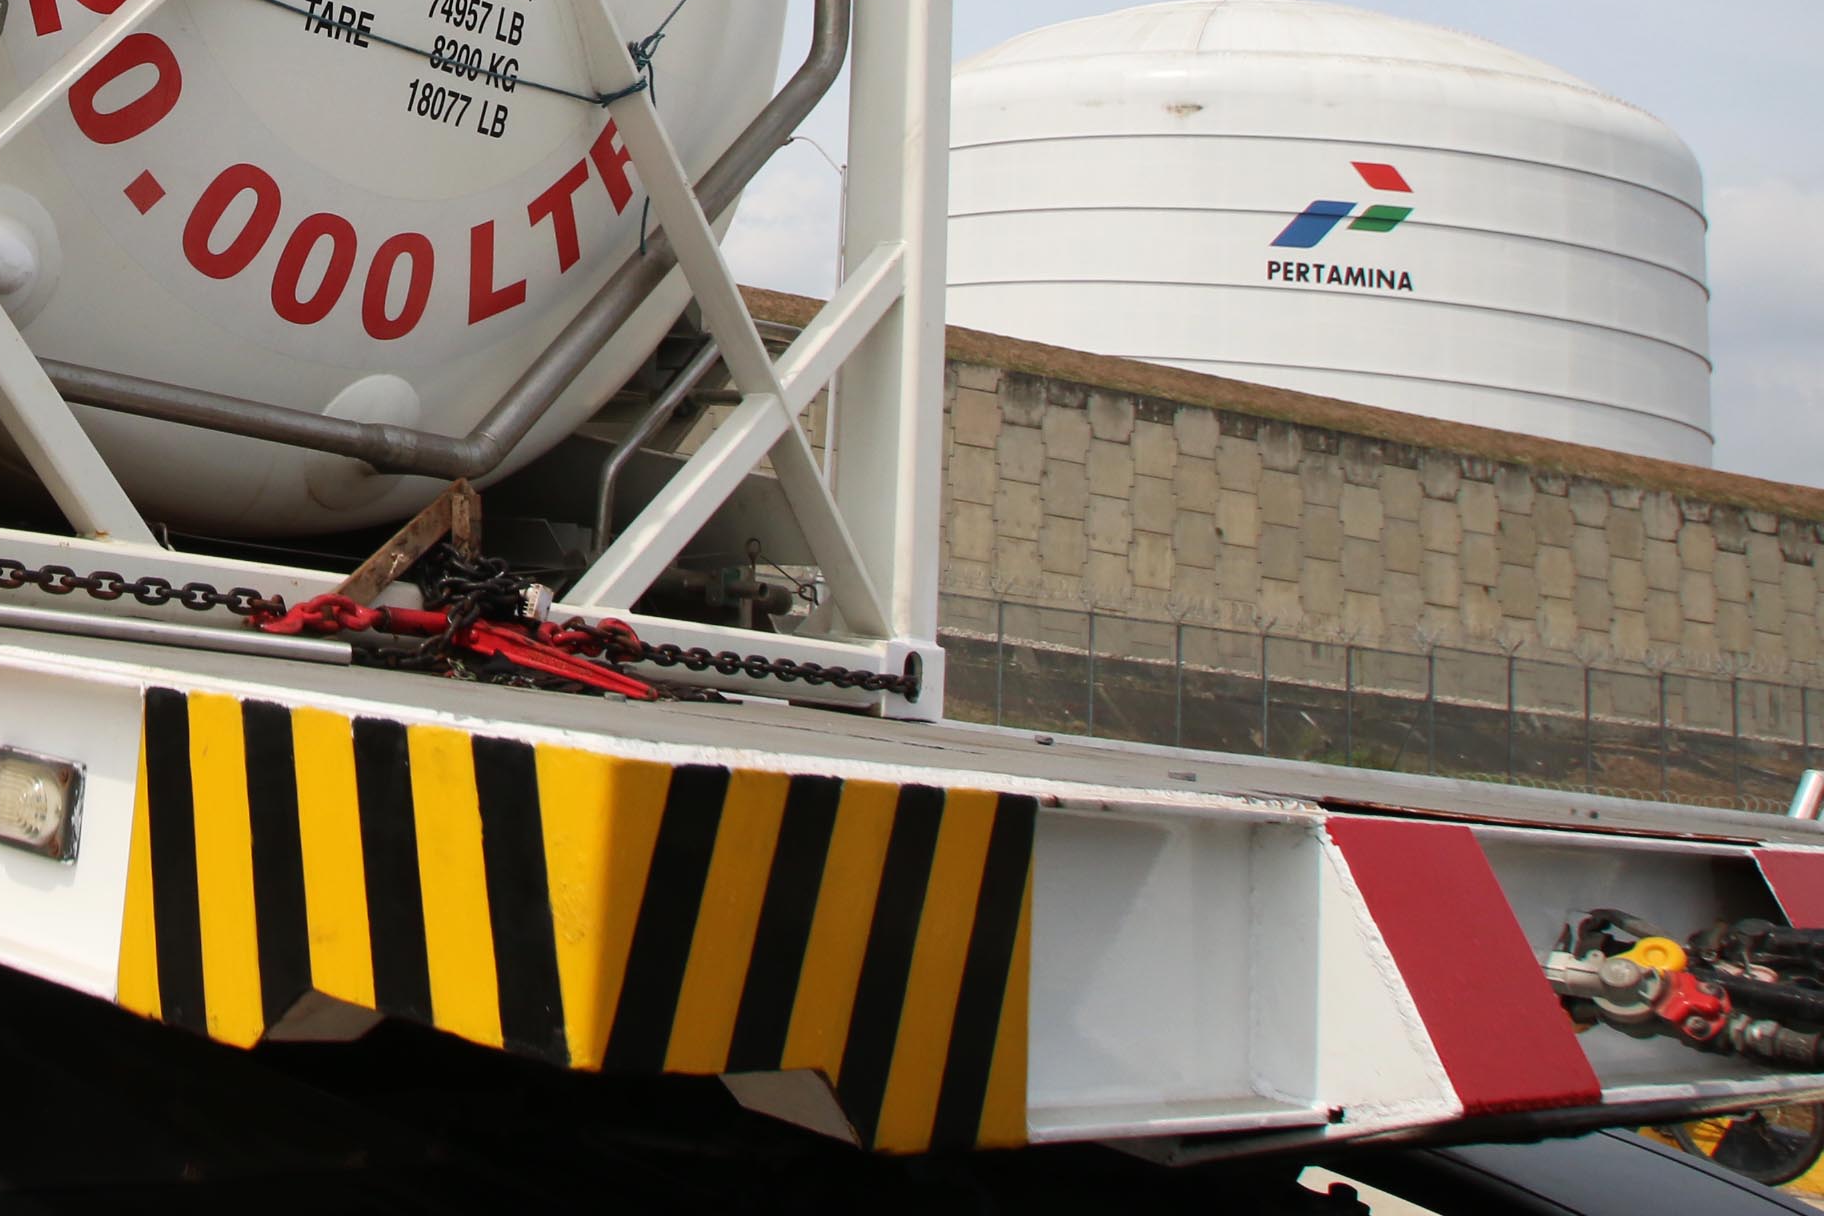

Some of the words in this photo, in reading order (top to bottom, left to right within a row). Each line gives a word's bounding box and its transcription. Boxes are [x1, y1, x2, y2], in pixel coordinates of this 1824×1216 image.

[495, 7, 525, 46] LB
[429, 35, 483, 82] 8200
[485, 53, 520, 93] KG
[407, 79, 472, 127] 18077
[477, 100, 509, 138] LB
[1266, 260, 1414, 292] PERTAMINA
